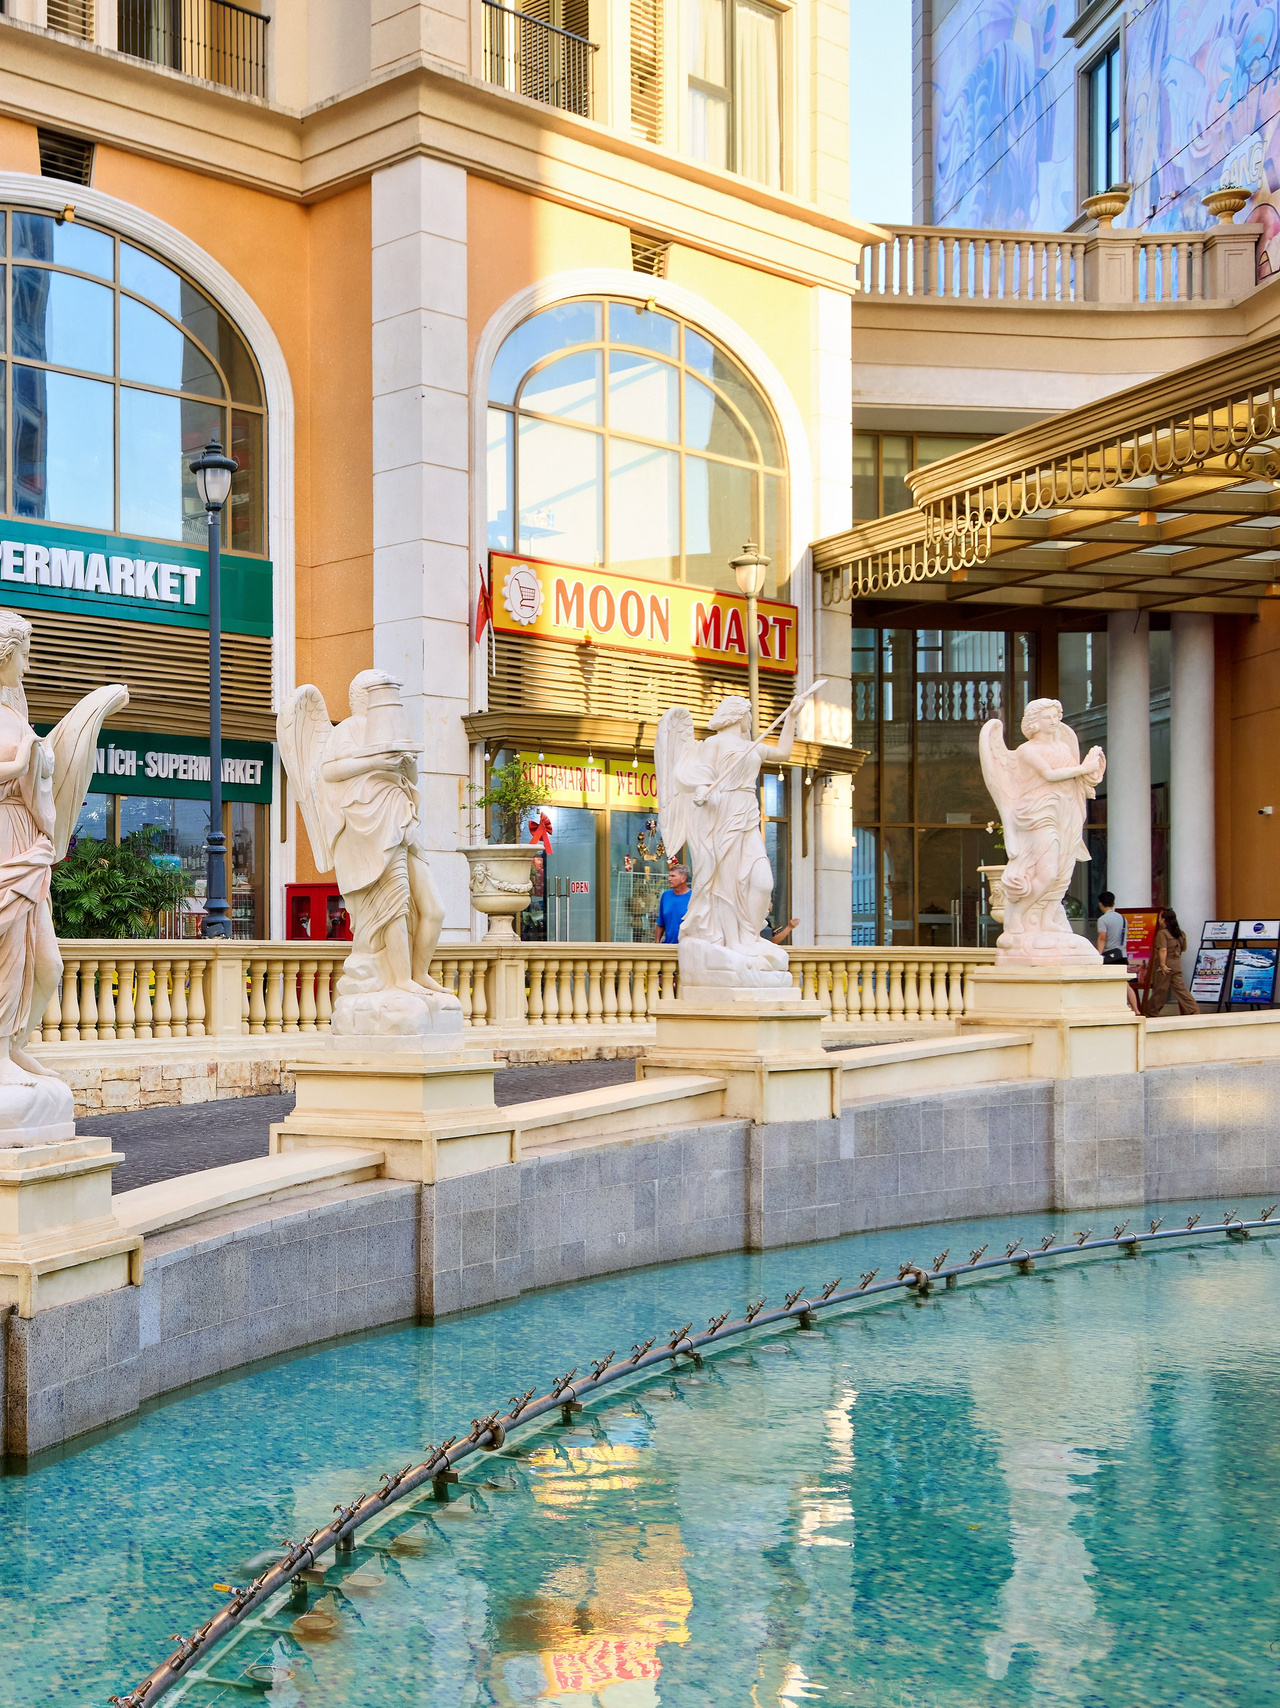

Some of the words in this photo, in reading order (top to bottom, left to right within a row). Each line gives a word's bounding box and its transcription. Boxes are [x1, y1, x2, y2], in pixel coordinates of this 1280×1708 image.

[553, 577, 671, 644] MOON
[691, 601, 794, 662] MART
[107, 743, 137, 776] ÍCH
[144, 751, 264, 785] SUPERMRKET
[615, 770, 658, 798] WELCO
[570, 880, 590, 894] OPEN
